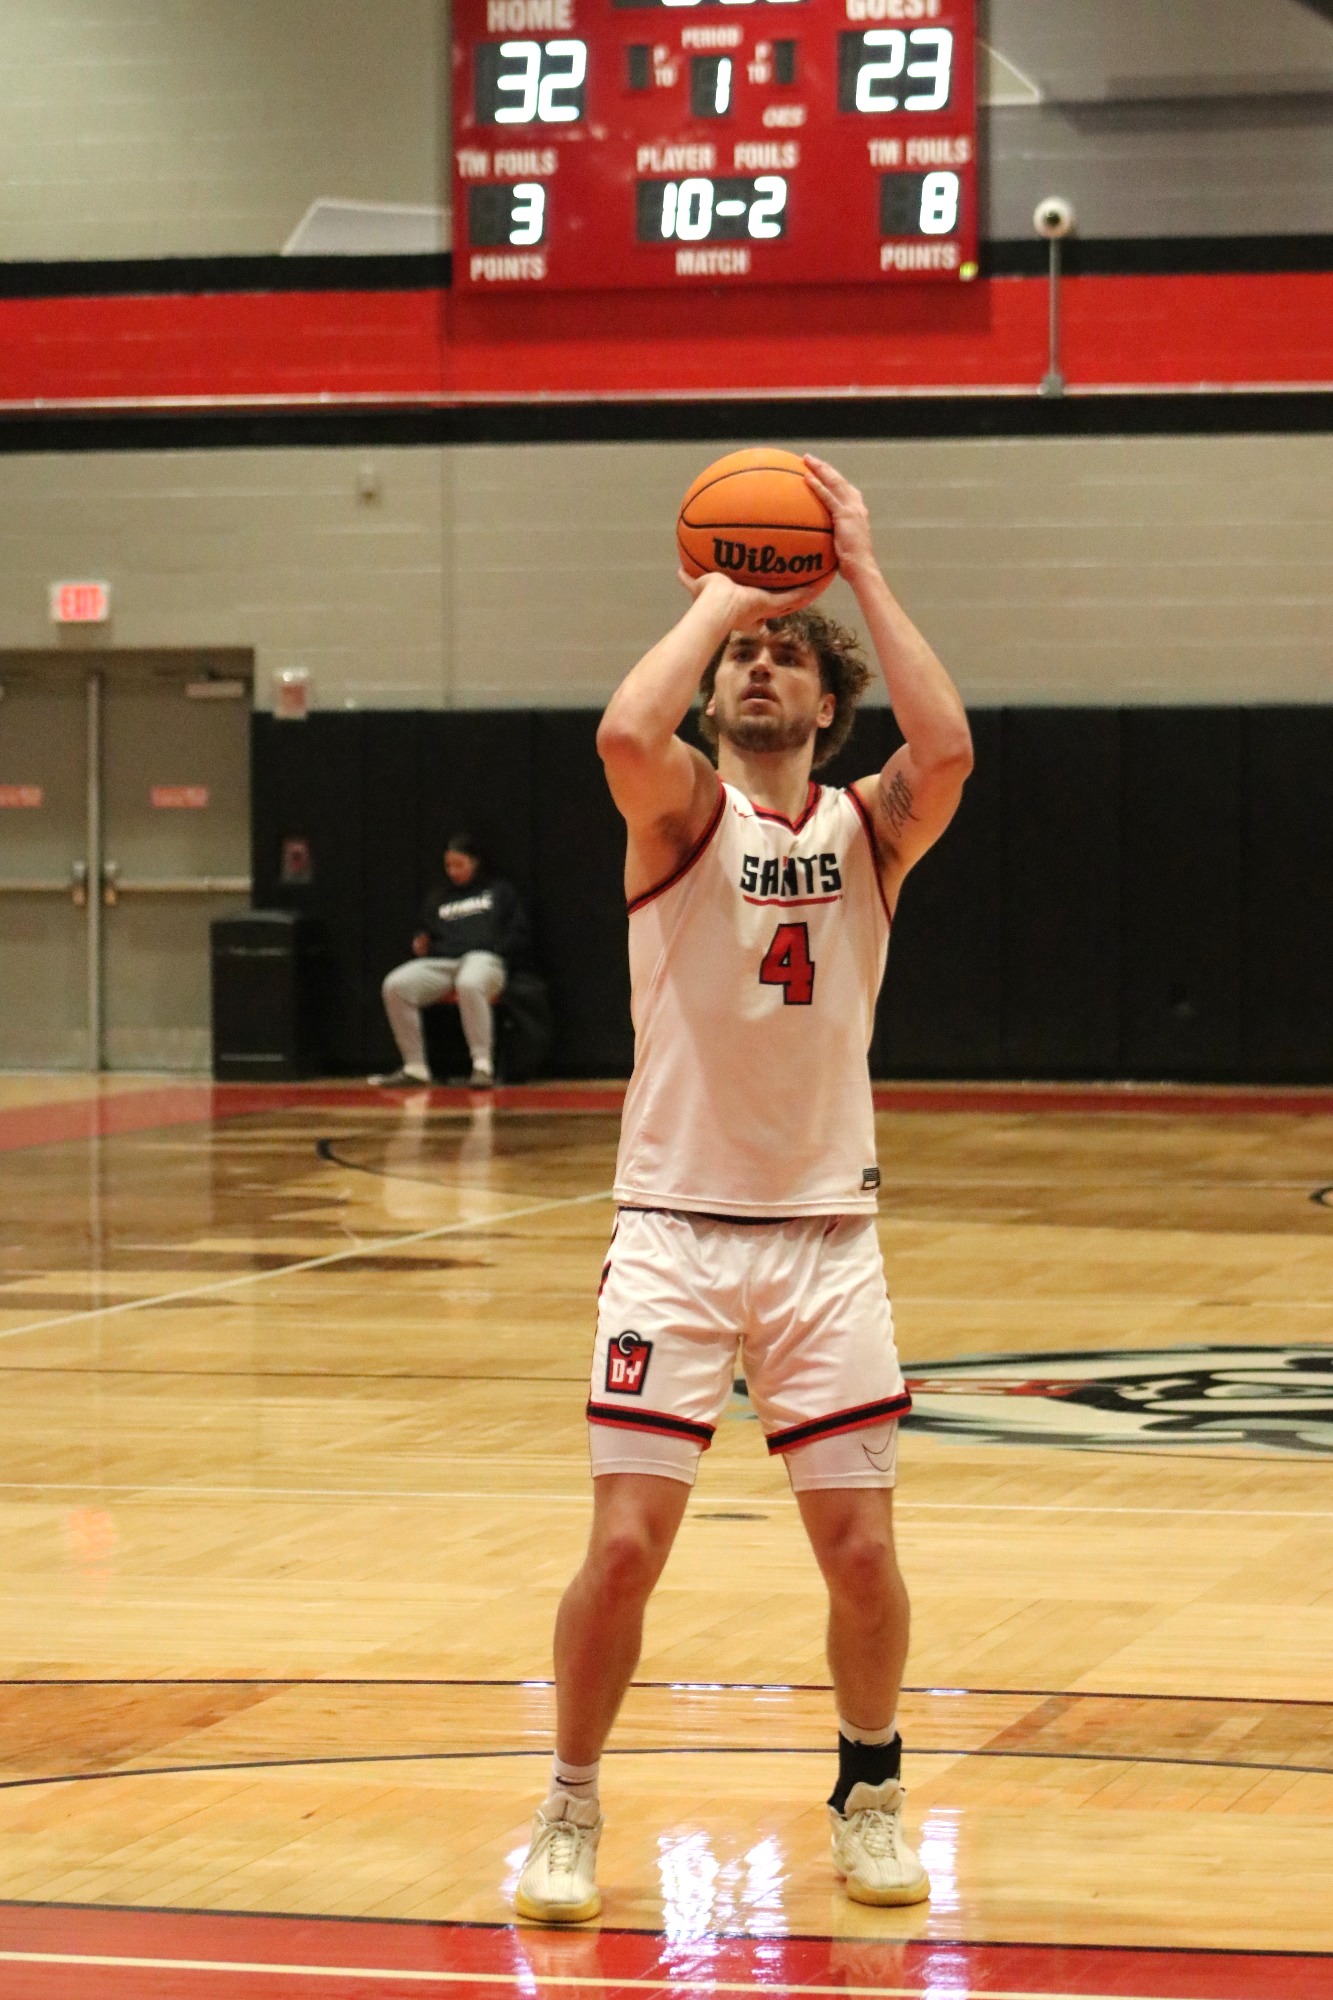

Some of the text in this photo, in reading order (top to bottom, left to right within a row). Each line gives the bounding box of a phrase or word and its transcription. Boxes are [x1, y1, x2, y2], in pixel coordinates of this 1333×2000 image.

[487, 0, 576, 33] HOME
[681, 25, 743, 49] PERIOD
[494, 39, 587, 124] 32
[714, 57, 732, 114] 1
[855, 27, 953, 113] 23
[493, 147, 557, 176] FOULS
[636, 138, 799, 173] PLAYER FOULS
[868, 134, 971, 167] TM FOULS
[509, 182, 545, 245] 3
[919, 171, 959, 234] 8
[470, 254, 546, 281] POINTS
[675, 248, 750, 276] MATCH
[881, 243, 959, 271] POINTS
[713, 537, 823, 575] Wilson
[759, 921, 816, 1006] 4
